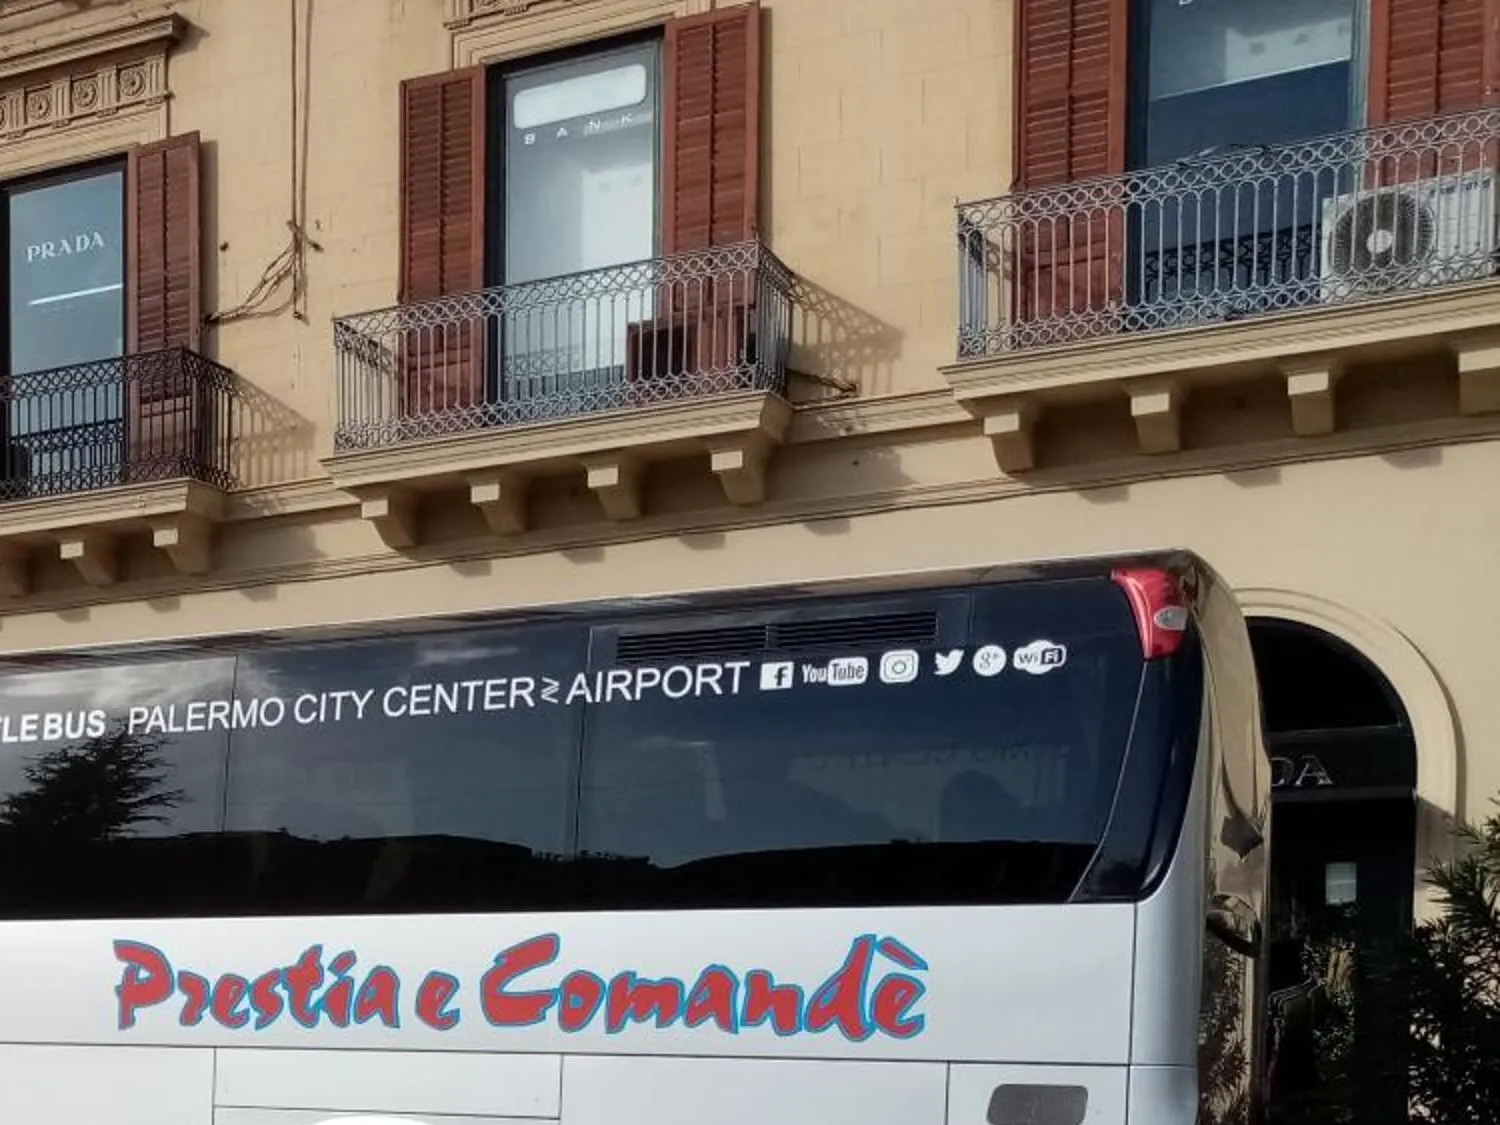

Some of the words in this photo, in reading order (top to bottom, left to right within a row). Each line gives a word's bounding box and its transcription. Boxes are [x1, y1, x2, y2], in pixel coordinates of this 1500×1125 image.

[26, 231, 105, 263] PRADA
[128, 698, 285, 734] PALERMO
[293, 688, 374, 724] CITY
[381, 676, 536, 718] CENTER
[565, 661, 751, 704] AIRPORT
[113, 940, 401, 1031] Prestia
[415, 971, 460, 1031] e
[479, 933, 928, 1043] Comandè
